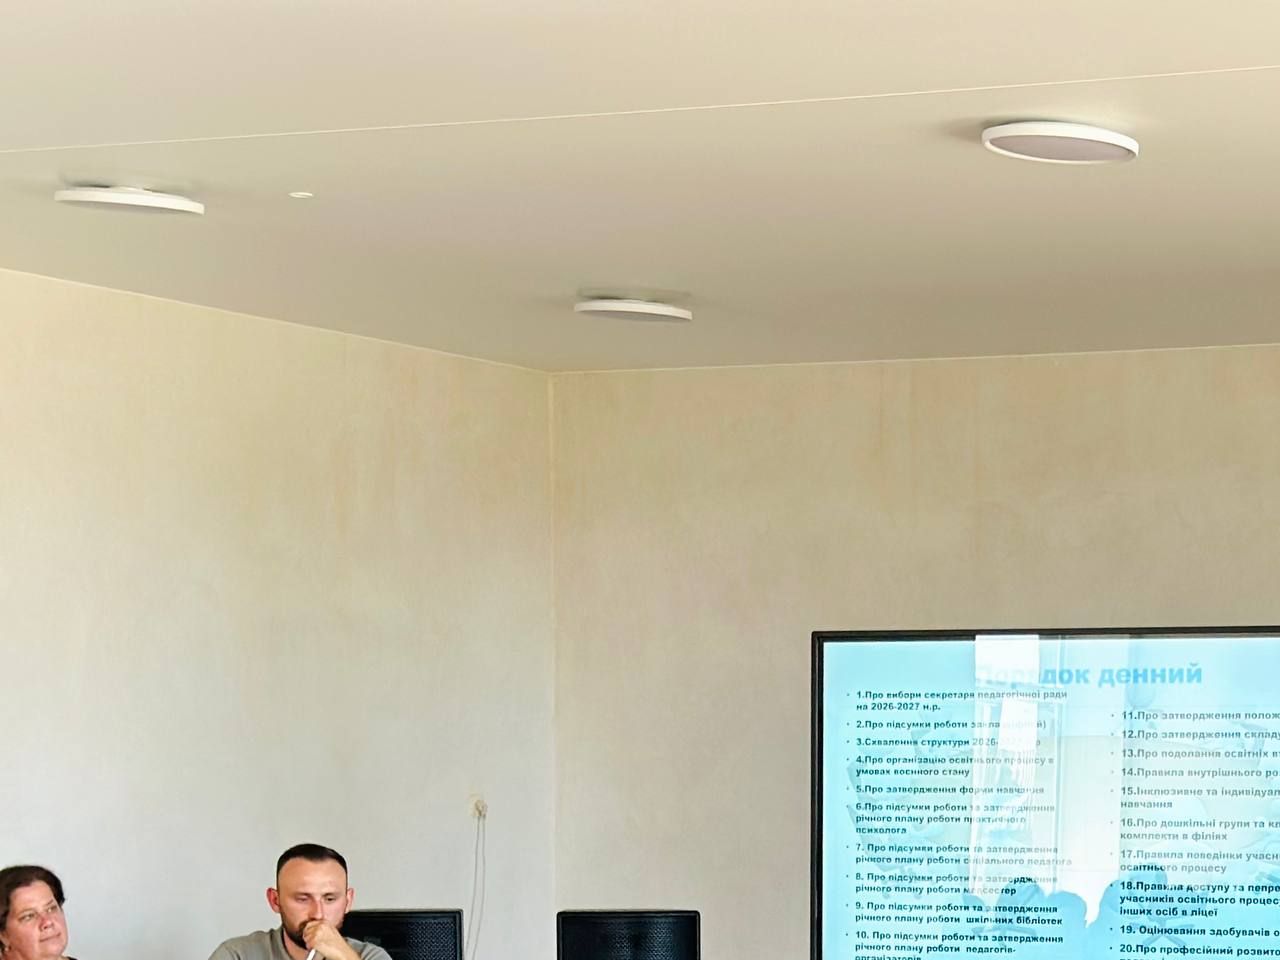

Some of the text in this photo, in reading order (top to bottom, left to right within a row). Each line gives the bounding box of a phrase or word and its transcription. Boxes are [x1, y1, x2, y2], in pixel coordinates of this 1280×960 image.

[1099, 663, 1203, 687] денний
[856, 691, 884, 700] 1.Про
[885, 691, 922, 699] вибори
[923, 692, 976, 700] секретаря
[1043, 691, 1068, 700] ради
[870, 703, 921, 711] 2026-2027
[922, 704, 942, 712] н.р.
[1121, 711, 1159, 721] 11.Про
[1160, 712, 1242, 720] затвердження
[856, 721, 884, 729] 2.Про
[885, 720, 931, 729] підсумки
[933, 720, 968, 729] роботи
[1121, 730, 1159, 740] 12.Про
[1160, 731, 1242, 739] затвердження
[856, 738, 919, 746] 3.Схвалення
[920, 739, 970, 747] структури
[1121, 750, 1159, 759] 13.Про
[1160, 750, 1222, 758] подолання
[1223, 749, 1269, 758] освітніх
[855, 756, 884, 765] 4.Про
[885, 756, 946, 765] організацію
[855, 768, 891, 777] умовах
[941, 769, 970, 777] стану
[1121, 769, 1185, 777] 14.Правила
[1187, 769, 1263, 778] внутрішнього
[855, 786, 884, 794] 5.Про
[885, 786, 957, 794] затвердження
[1121, 787, 1203, 796] 15.Інклюзивне
[855, 804, 884, 812] 6.Про
[885, 803, 931, 812] підсумки
[933, 804, 968, 812] роботи
[855, 815, 893, 824] річного
[894, 816, 925, 824] плану
[926, 815, 961, 824] роботи
[1120, 819, 1158, 828] 16.Про
[1160, 819, 1216, 828] дошкільні
[1218, 820, 1251, 829] групи
[1119, 832, 1179, 840] комплекти
[1191, 831, 1228, 841] філіях
[866, 844, 886, 853] Про
[887, 844, 933, 853] підсумки
[935, 845, 970, 853] роботи
[894, 857, 925, 865] плану
[926, 856, 961, 865] роботи
[963, 857, 1025, 865] сціального
[1120, 851, 1184, 859] 17.Правила
[1186, 851, 1243, 861] поведінки
[1119, 864, 1228, 874] освітнього процесу
[866, 874, 886, 882] Про
[887, 874, 933, 882] підсумки
[935, 874, 970, 883] роботи
[855, 885, 892, 894] річного
[894, 886, 924, 894] плану
[926, 885, 961, 894] роботи
[1186, 884, 1231, 893] доступу
[1233, 884, 1245, 892] та
[1119, 895, 1175, 904] учасників
[1177, 896, 1236, 904] освітнього
[866, 903, 886, 912] Про
[887, 903, 933, 912] підсумки
[935, 904, 970, 913] роботи
[1119, 908, 1153, 916] інших
[1154, 908, 1179, 916] осіб
[1190, 908, 1218, 917] ліцеї
[855, 915, 892, 923] річного
[894, 916, 924, 924] плану
[926, 915, 961, 924] роботи
[1015, 916, 1063, 925] бібліотек
[1119, 926, 1136, 934] 19.
[1138, 926, 1206, 935] Оцінювання
[1208, 927, 1271, 937] здобувачів
[872, 932, 891, 940] Про
[893, 932, 939, 941] підсумки
[941, 933, 976, 942] роботи
[991, 935, 1064, 944] затвердження
[854, 944, 1017, 955] річного плану роботи педагогів-
[1119, 945, 1157, 954] 20.Про
[1159, 946, 1234, 955] професійний
